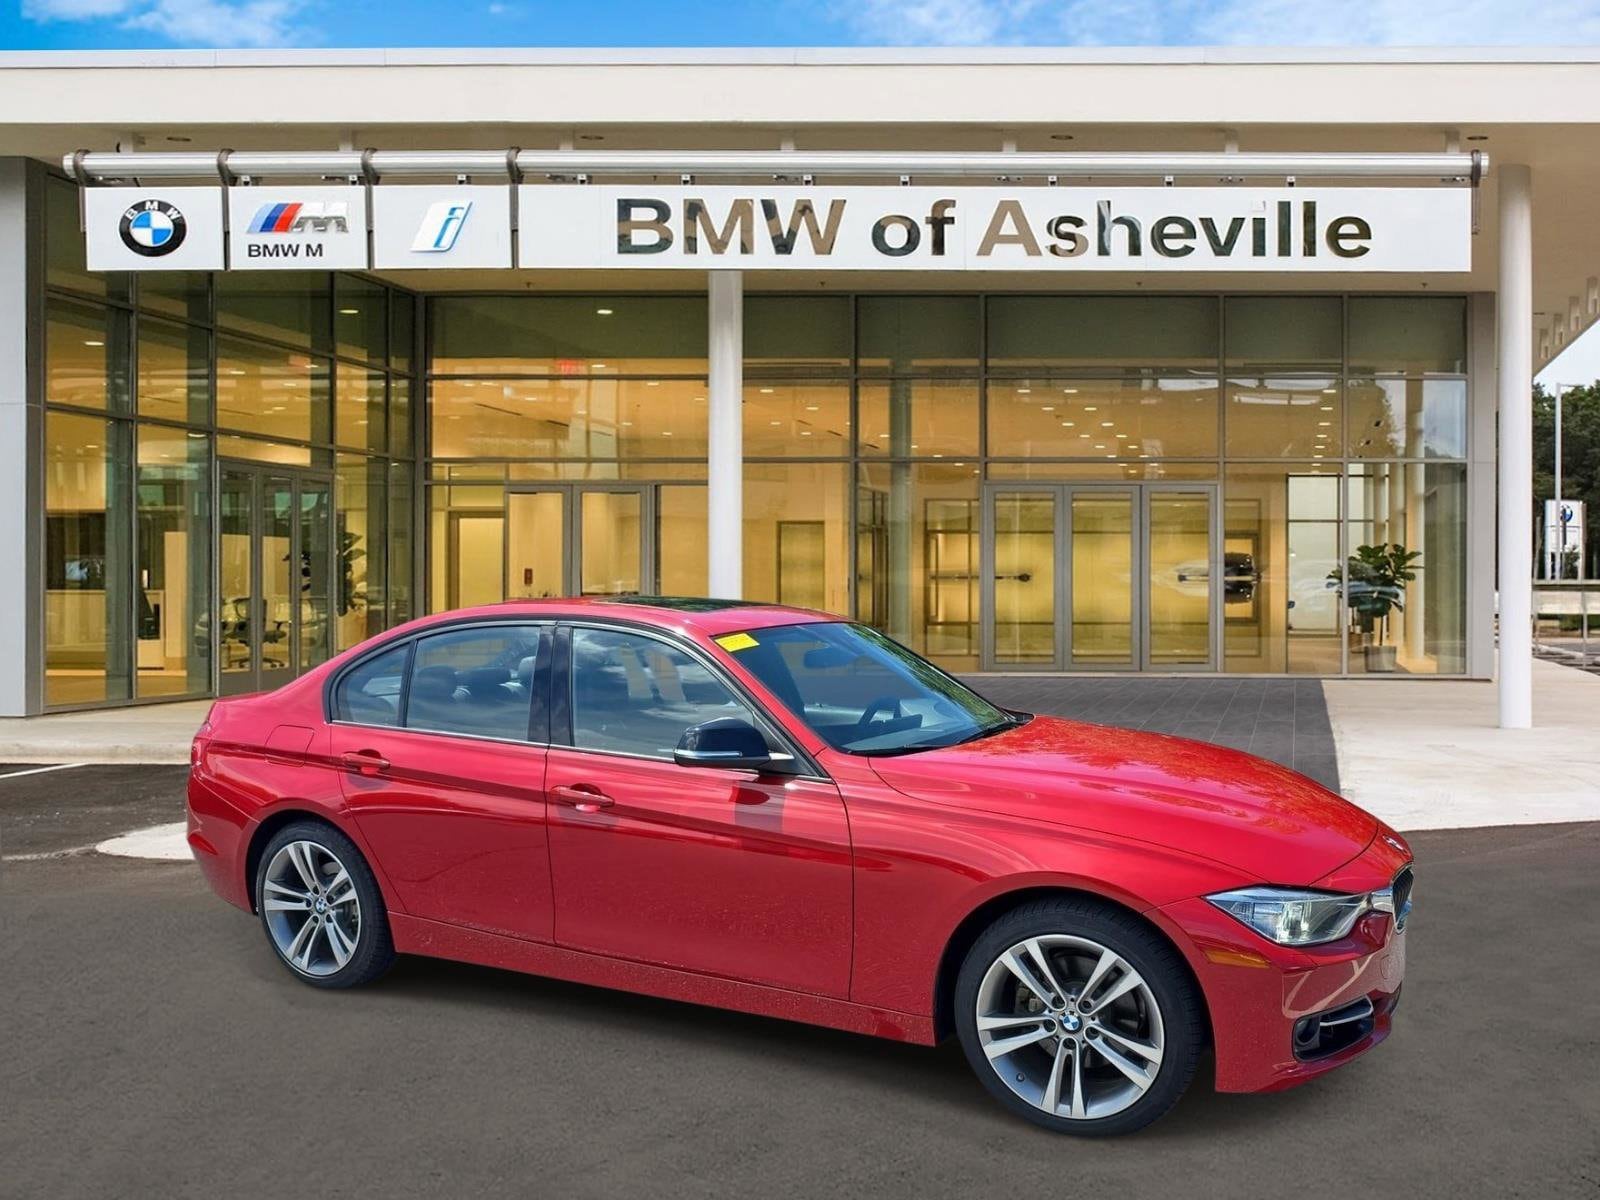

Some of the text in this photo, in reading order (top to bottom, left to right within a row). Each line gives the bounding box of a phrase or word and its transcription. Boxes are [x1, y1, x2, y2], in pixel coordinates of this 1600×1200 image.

[616, 198, 1372, 258] BMW of Asheville
[248, 244, 323, 258] BMW M
